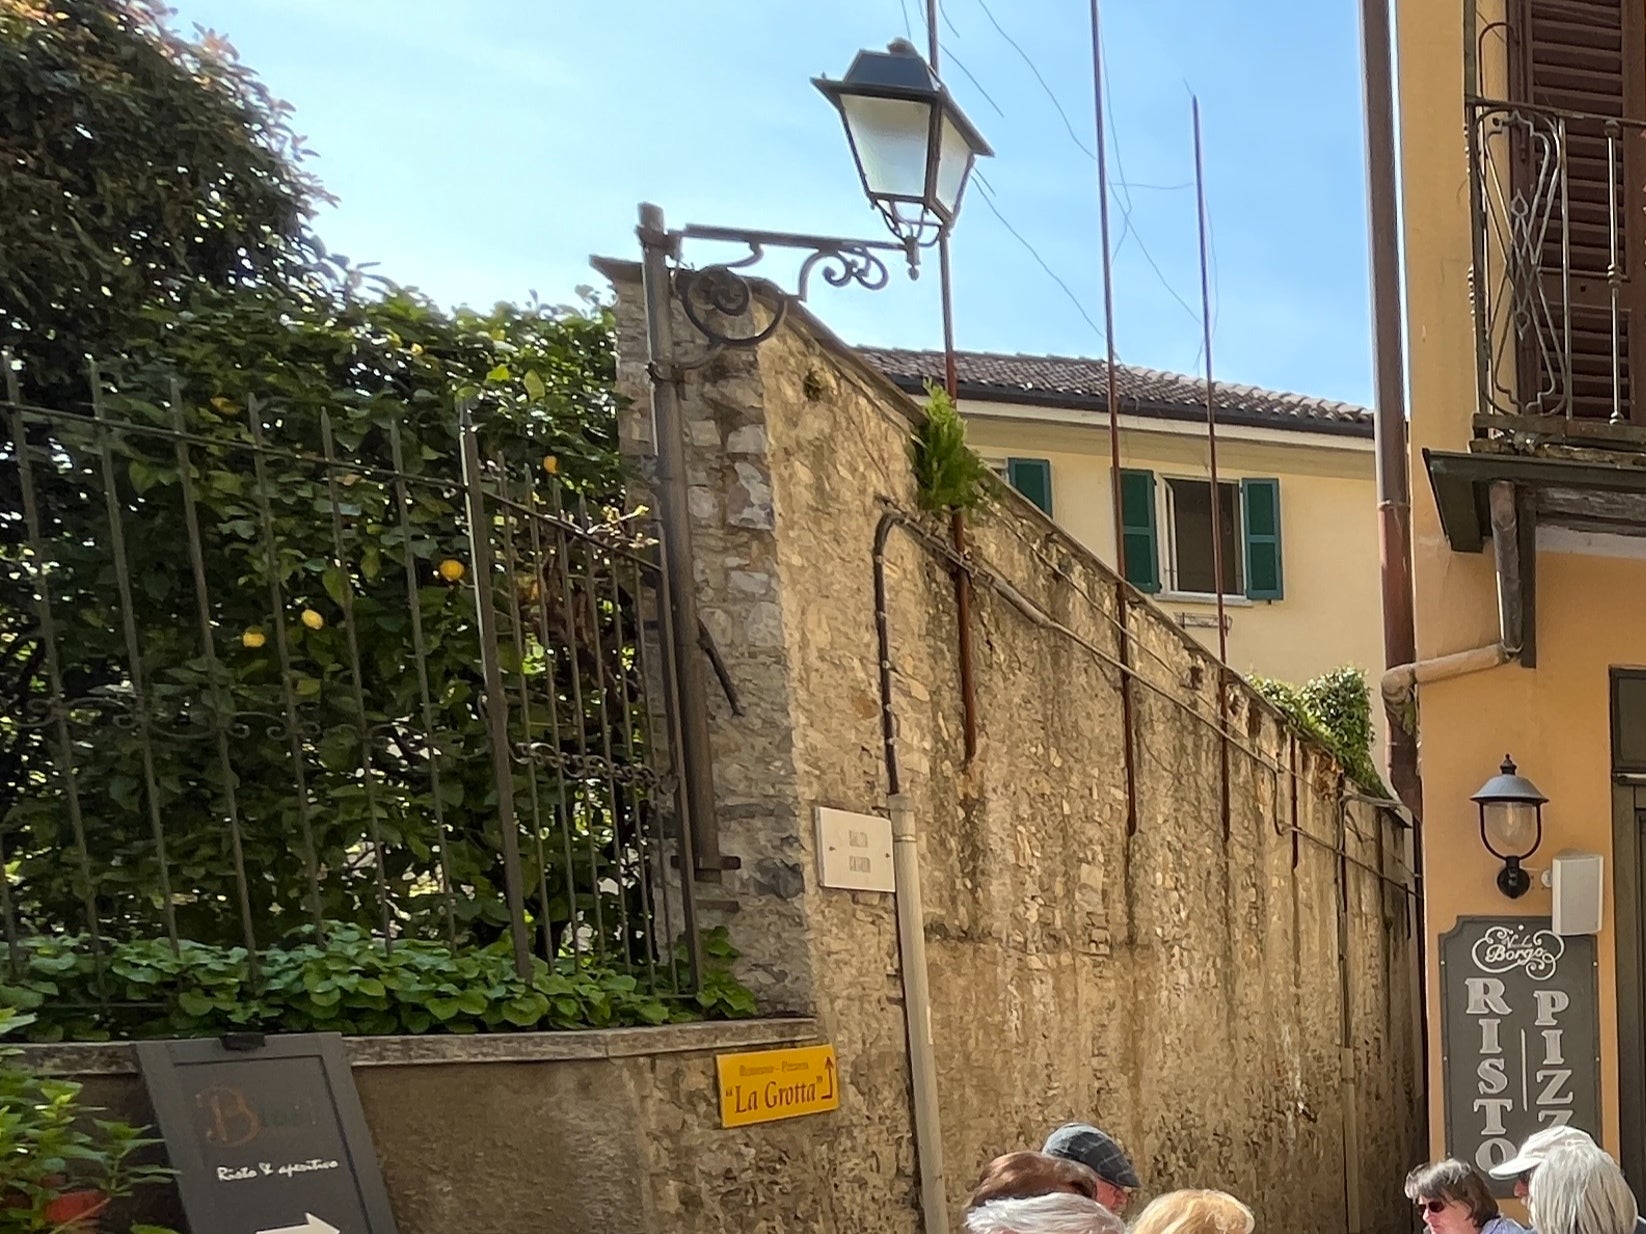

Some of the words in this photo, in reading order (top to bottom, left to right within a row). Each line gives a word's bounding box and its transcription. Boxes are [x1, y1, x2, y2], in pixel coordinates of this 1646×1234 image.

[1485, 944, 1545, 966] Borgo
[1533, 990, 1575, 1129] PIZZ
[217, 1165, 258, 1182] Risto
